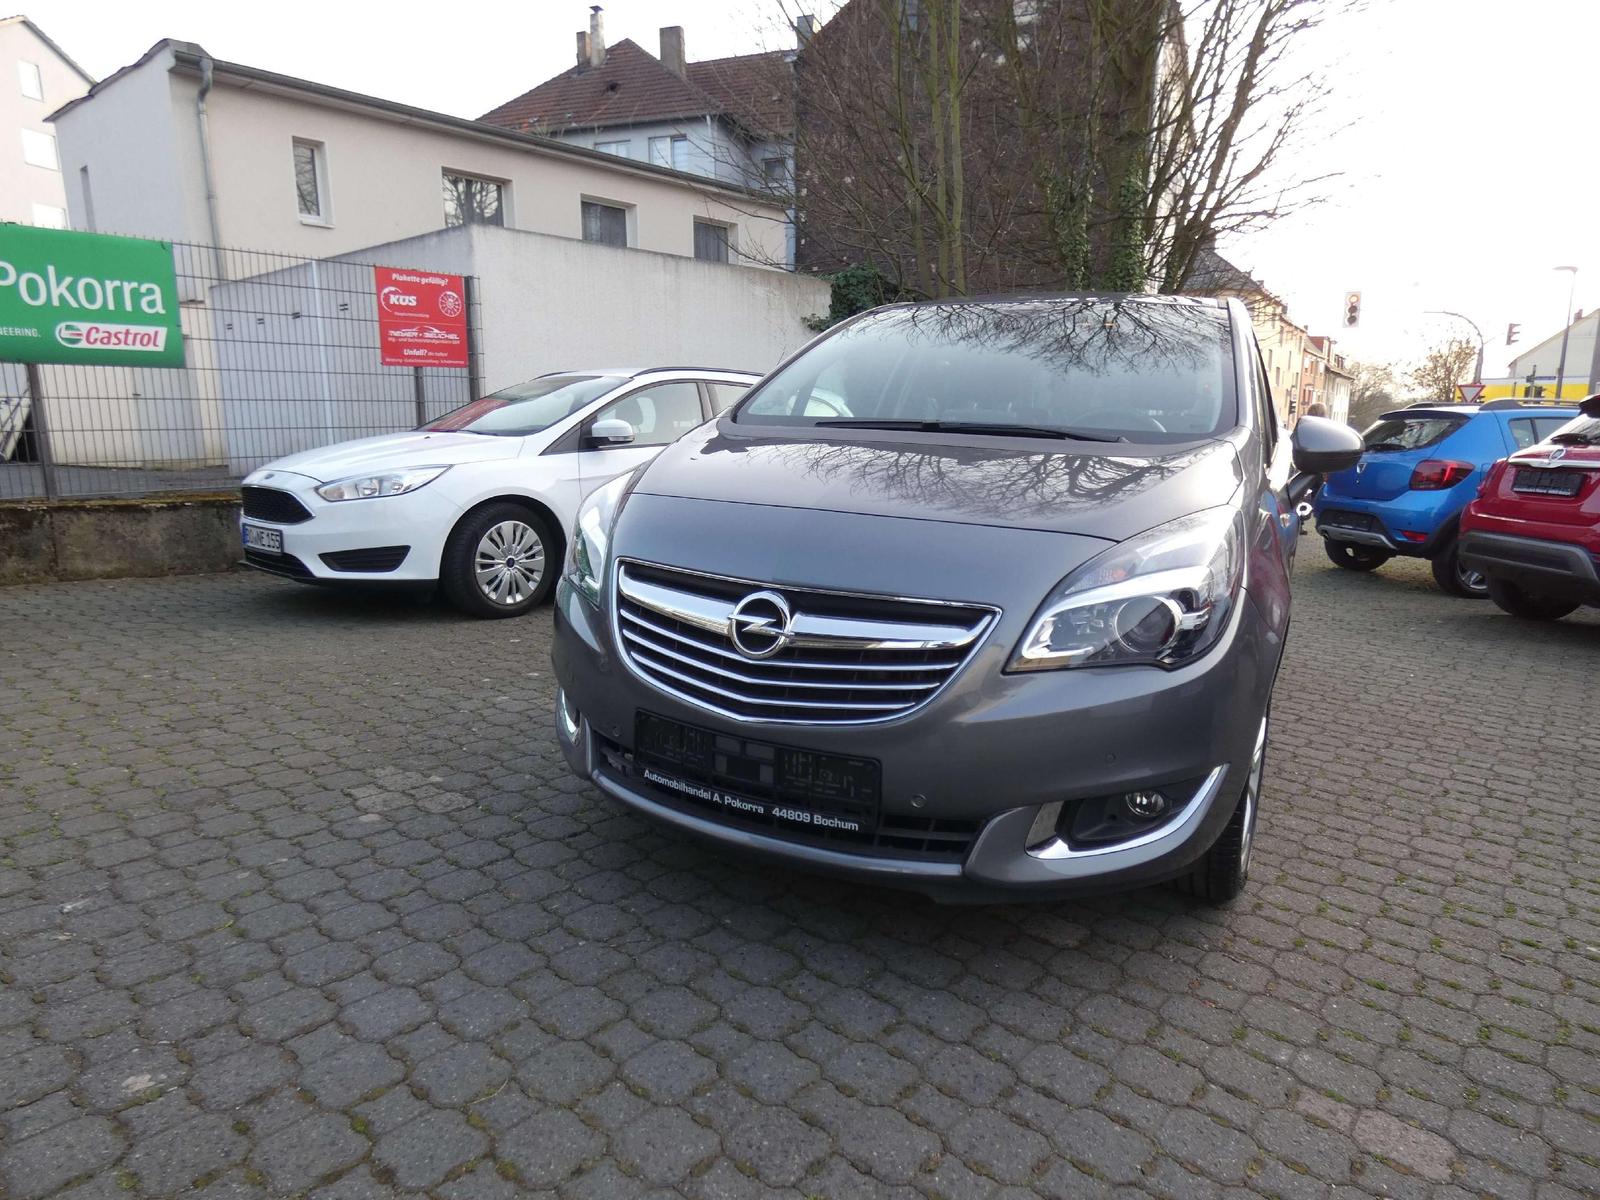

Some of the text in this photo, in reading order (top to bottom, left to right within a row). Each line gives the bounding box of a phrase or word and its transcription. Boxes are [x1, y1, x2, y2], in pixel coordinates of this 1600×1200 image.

[392, 273, 449, 287] Plakette gefällig?
[85, 326, 160, 348] Castrol
[403, 348, 428, 356] Unfall?
[643, 769, 860, 832] Automobilhandel A. Pokorra 44809 Bochum
